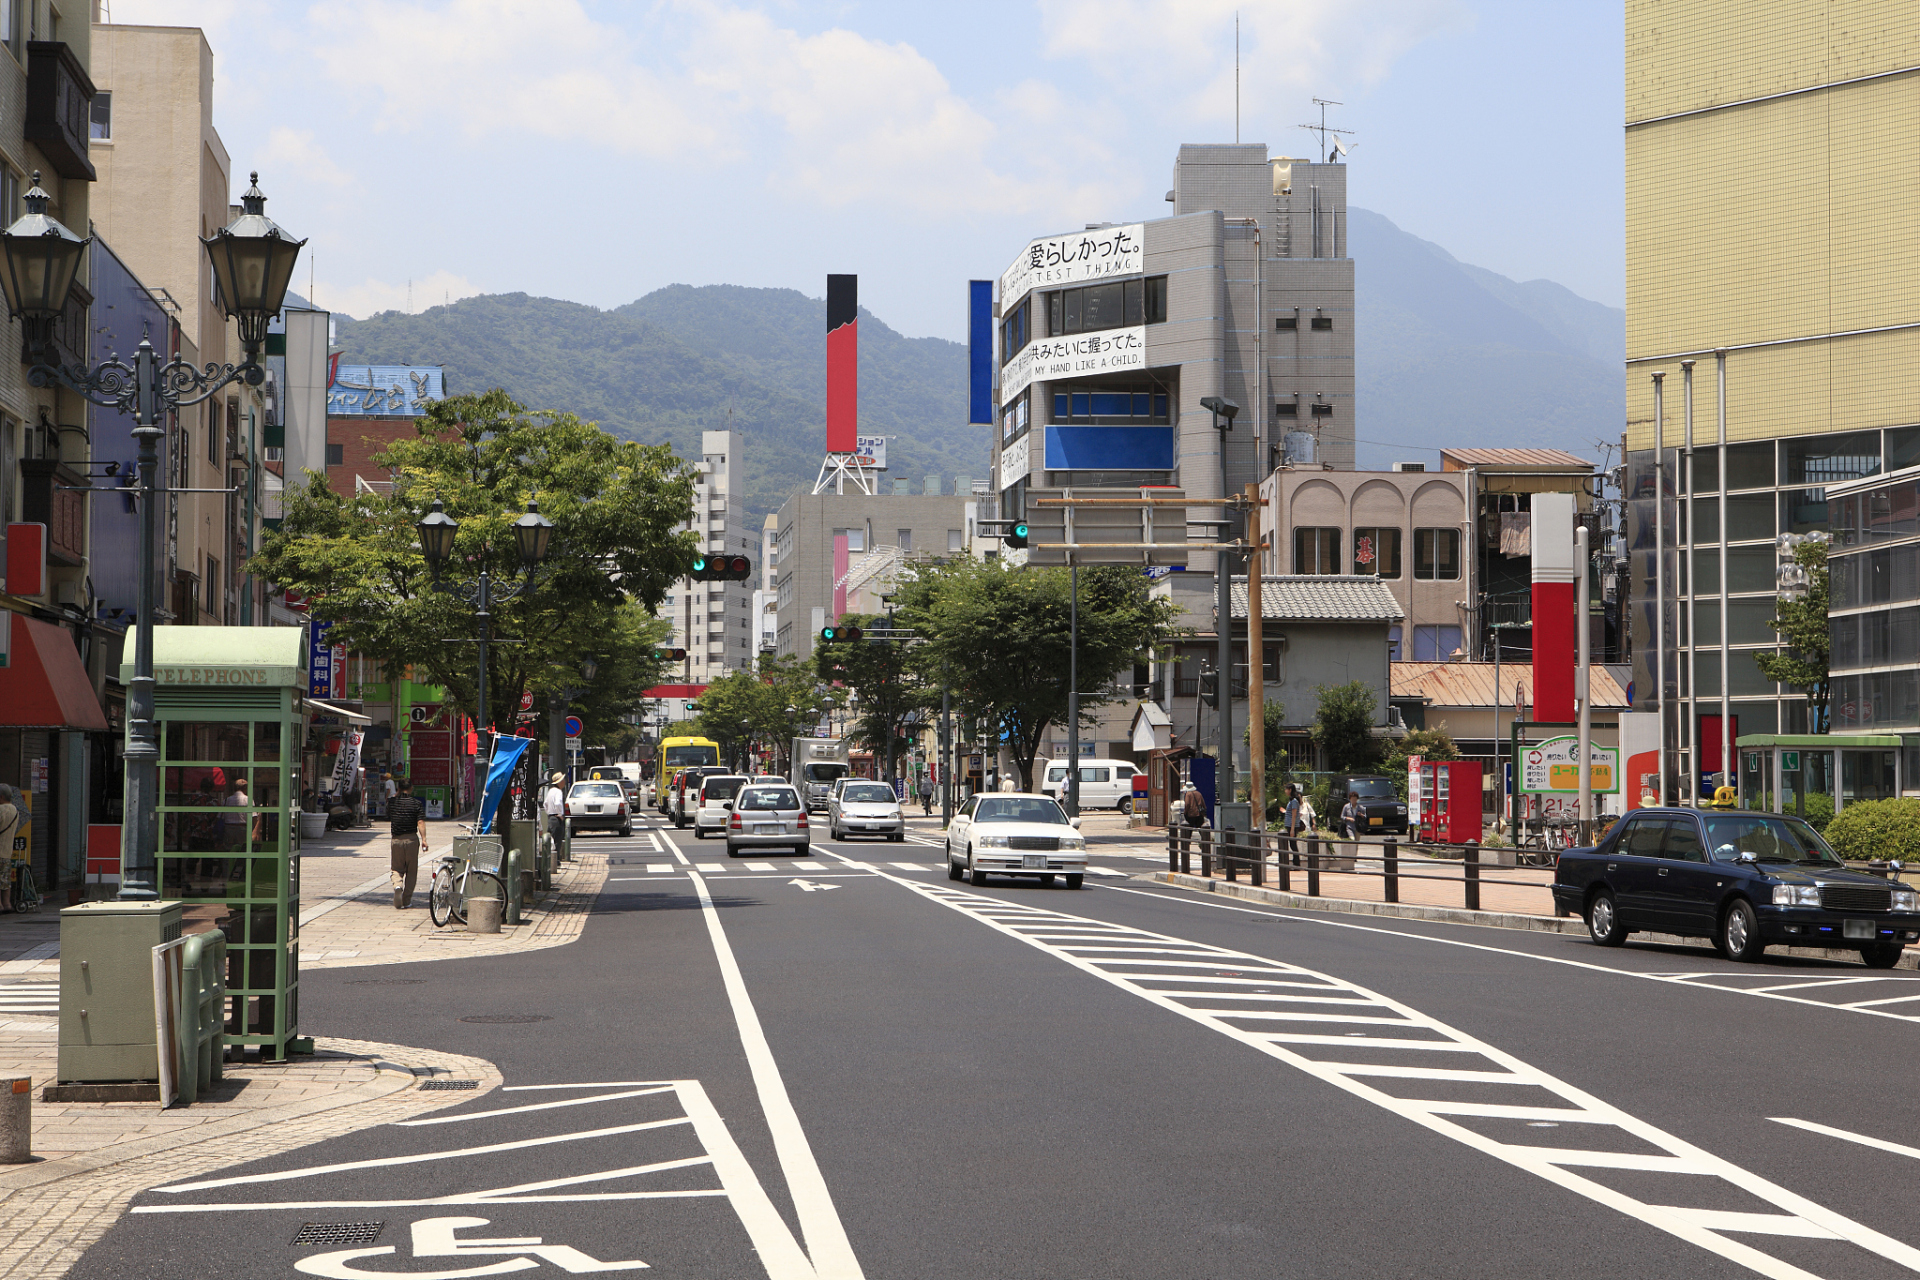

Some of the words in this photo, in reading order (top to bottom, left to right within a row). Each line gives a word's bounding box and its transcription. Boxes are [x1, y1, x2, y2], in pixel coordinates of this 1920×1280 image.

[1028, 231, 1140, 270] 愛らしかった。
[1085, 259, 1140, 275] THING.
[1034, 365, 1045, 376] MY
[1050, 362, 1071, 375] HAND
[1075, 359, 1097, 371] LIKE
[1101, 357, 1107, 367] A
[1111, 353, 1142, 367] CHILD.
[1355, 536, 1376, 565] 碁
[152, 668, 268, 685] TELEPHONE
[313, 685, 329, 695] 2F
[354, 686, 377, 694] PAZA
[971, 757, 979, 765] P
[1553, 766, 1580, 776] ユーカ
